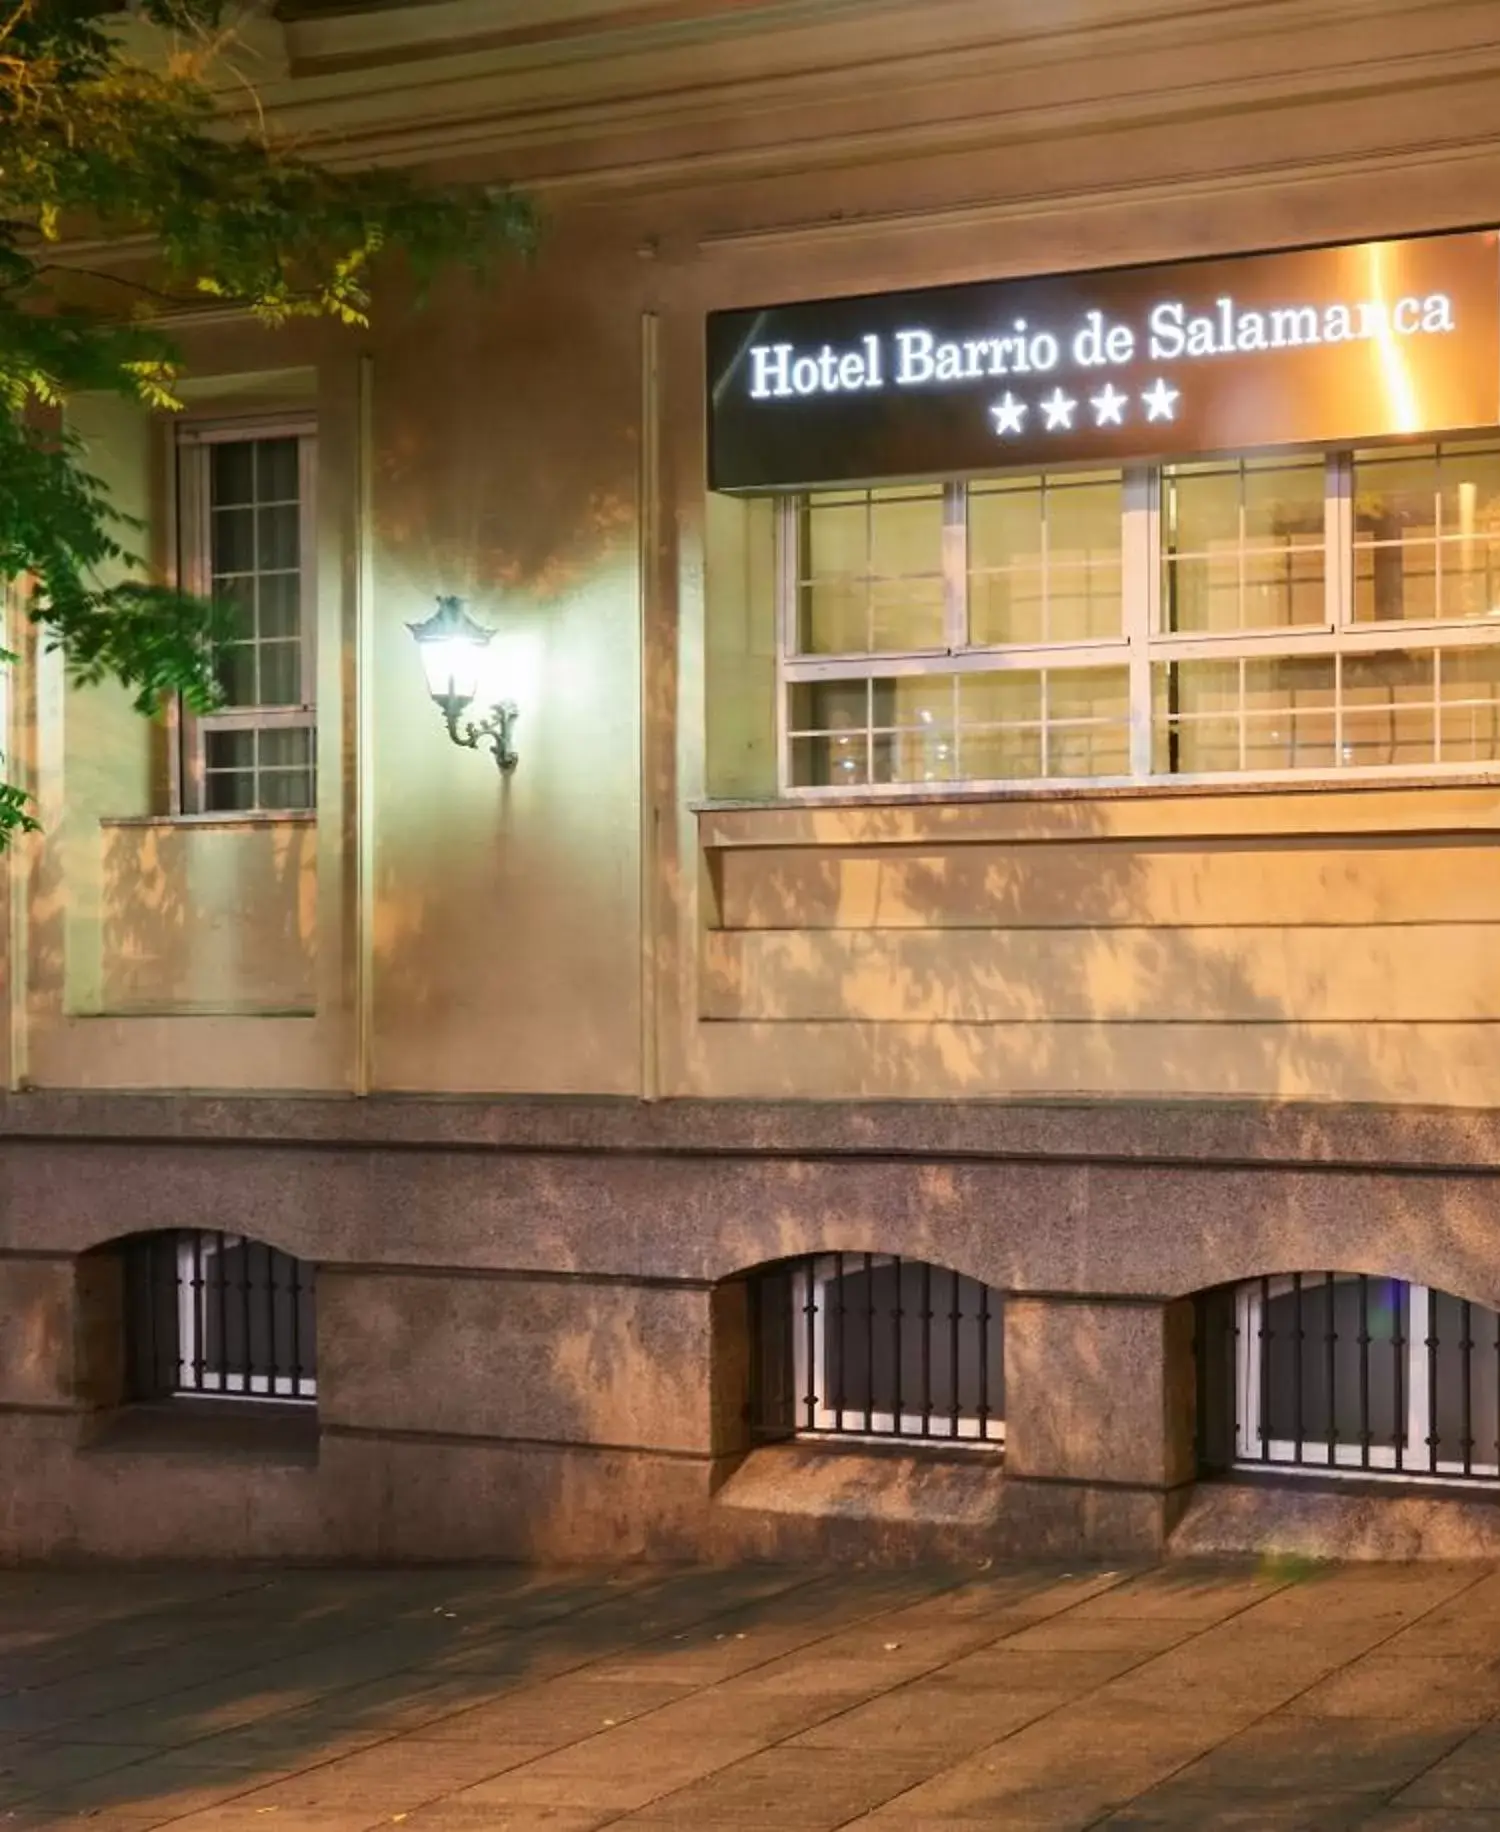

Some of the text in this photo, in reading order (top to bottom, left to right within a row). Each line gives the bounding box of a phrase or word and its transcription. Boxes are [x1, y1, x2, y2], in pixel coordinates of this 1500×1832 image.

[748, 291, 1455, 399] Hotel Barrio de Salamanca
